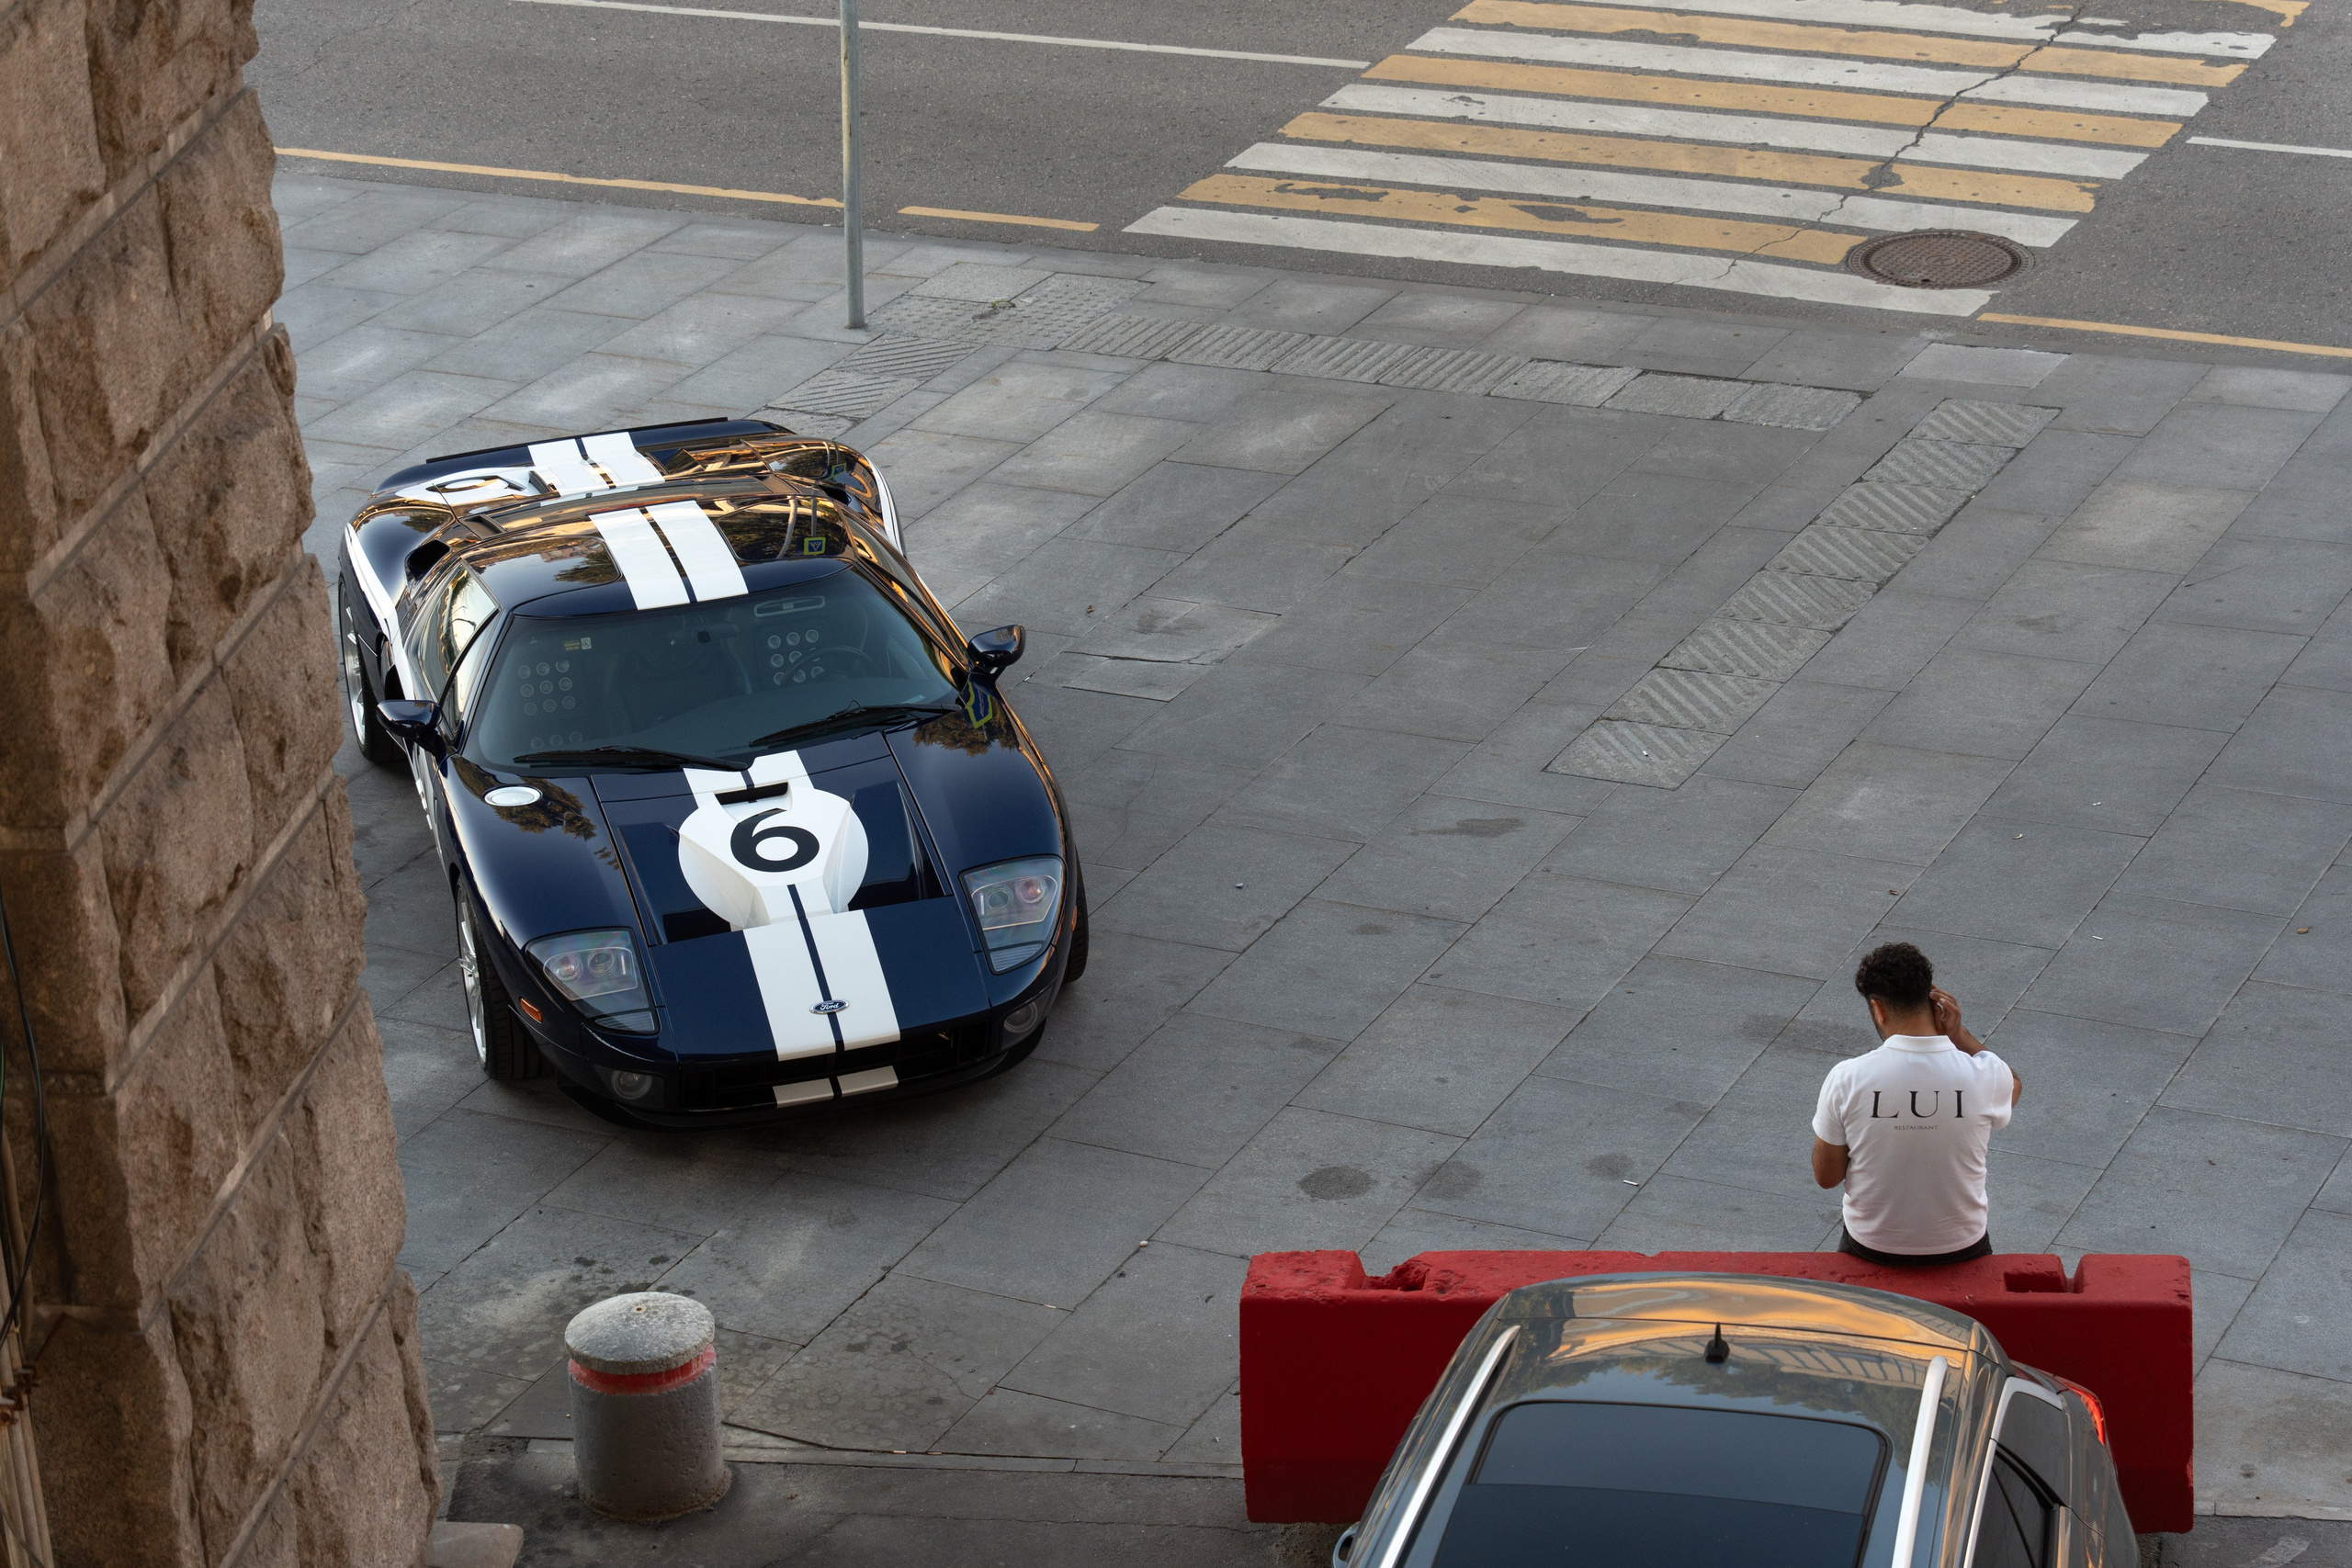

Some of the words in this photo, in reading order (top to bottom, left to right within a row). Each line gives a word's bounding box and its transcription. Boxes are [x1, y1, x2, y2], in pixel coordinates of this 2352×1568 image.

[730, 807, 820, 873] 6
[820, 1001, 840, 1010] Ford
[1871, 1090, 1964, 1118] LUI
